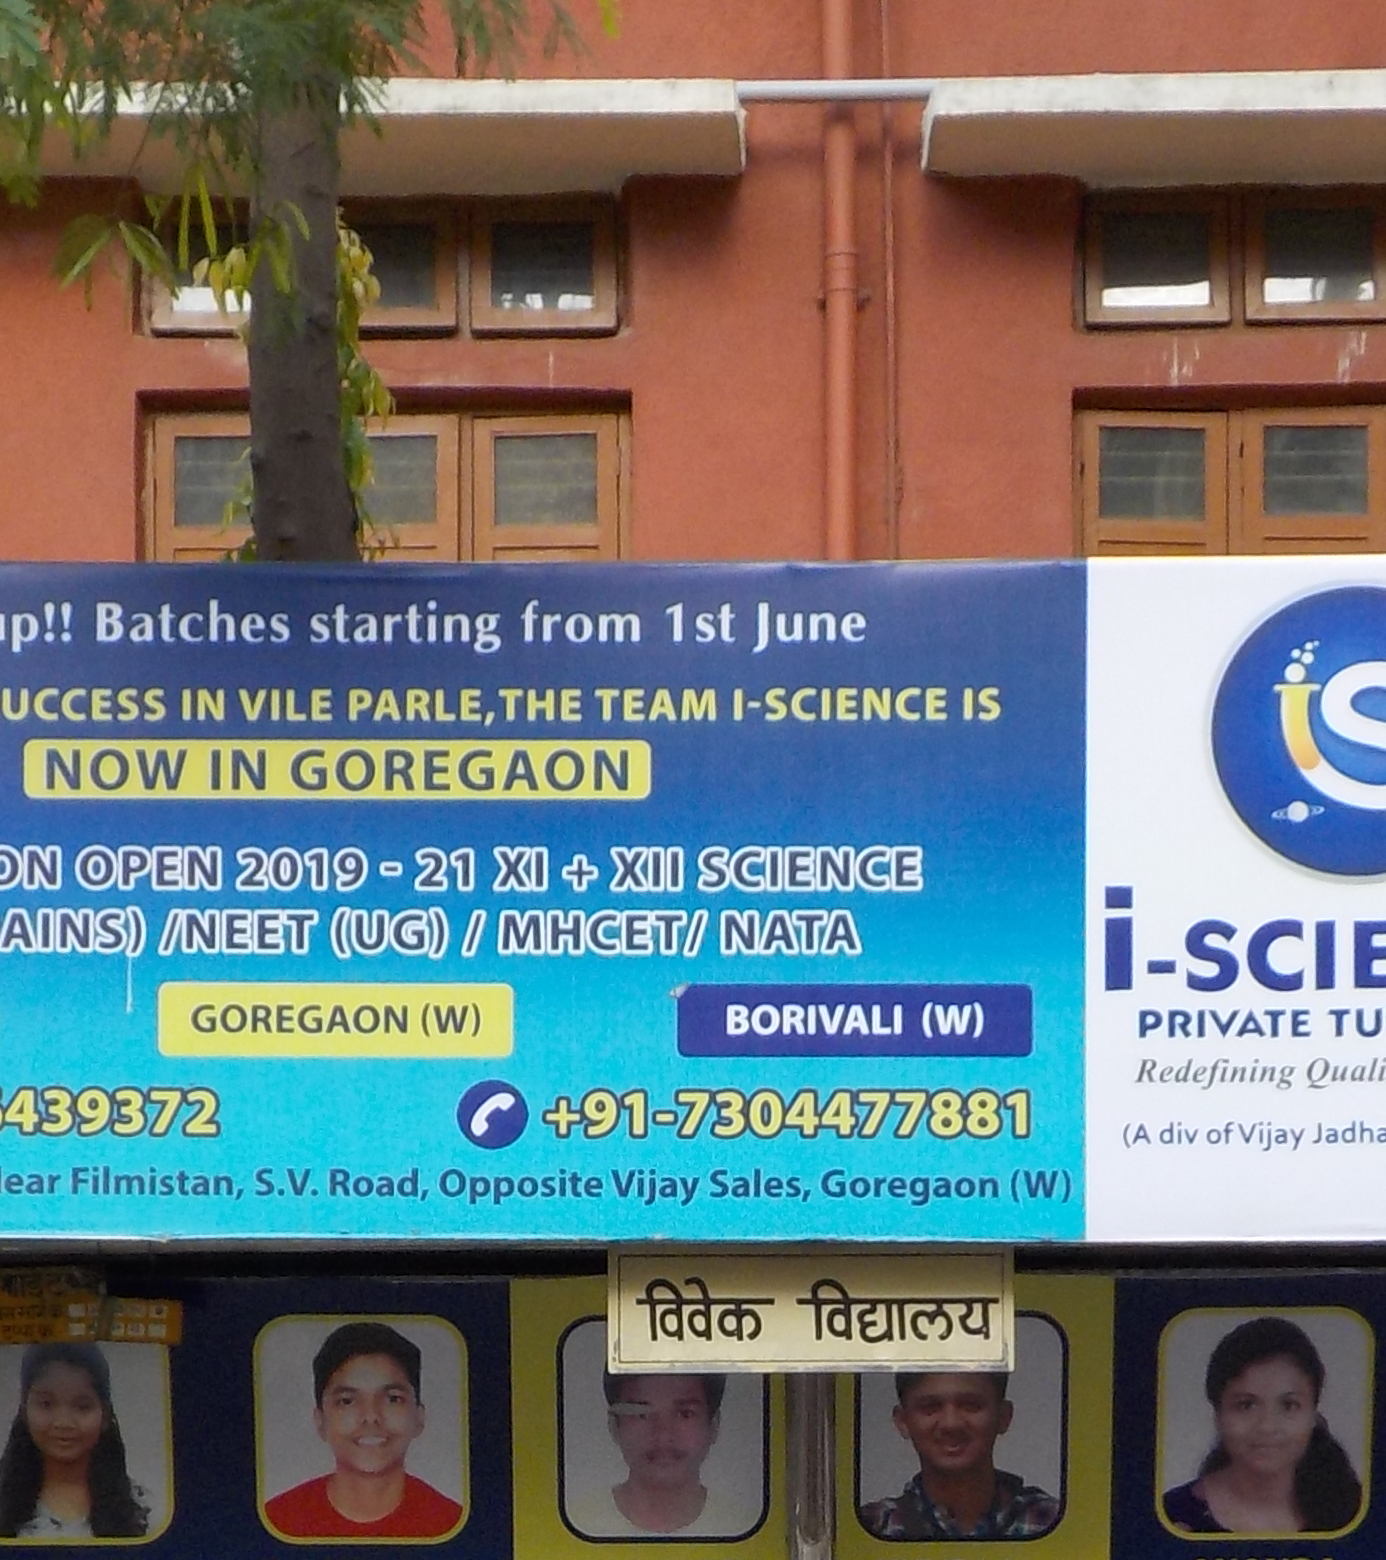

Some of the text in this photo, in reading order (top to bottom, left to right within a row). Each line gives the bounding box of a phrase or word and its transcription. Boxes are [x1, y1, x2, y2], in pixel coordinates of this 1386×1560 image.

[94, 600, 290, 644] Batches
[309, 600, 501, 653] starting
[521, 600, 641, 644] from
[666, 602, 736, 644] 1st
[753, 601, 867, 653] June
[181, 687, 224, 722] IN
[240, 687, 332, 722] VILE
[595, 688, 717, 722] TEAM
[732, 687, 948, 722] I-SCIENCE
[963, 687, 1002, 722] IS
[45, 748, 631, 792] NOW IN GOREGAON
[75, 845, 223, 891] OPEN
[235, 846, 368, 891] 2019
[414, 847, 476, 892] 21
[492, 847, 549, 892] XI
[610, 847, 684, 892] XII
[696, 846, 924, 892] SCIENCE
[329, 907, 449, 959] (UG)
[719, 909, 864, 957] NATA
[191, 1003, 483, 1040] GOREGAON (W)
[725, 1003, 985, 1040] BORIVALI (W)
[1137, 1008, 1313, 1039] PRIVATE
[1134, 1056, 1297, 1091] Redefining
[541, 1088, 1033, 1141] +91-7304477881
[1121, 1124, 1153, 1149] (A
[1159, 1123, 1199, 1147] div
[1206, 1122, 1234, 1146] of
[1239, 1122, 1306, 1153] Vijay
[71, 1164, 245, 1201] Filmistan,
[255, 1168, 319, 1197] S.V.
[329, 1167, 430, 1203] Road,
[439, 1168, 604, 1206] Opposite
[612, 1168, 700, 1206] Vijay
[709, 1168, 812, 1204] Sales,
[821, 1169, 1000, 1207] Goregaon
[1009, 1168, 1073, 1204] (W)
[636, 1276, 1000, 1343] विवेक विद्यालय
